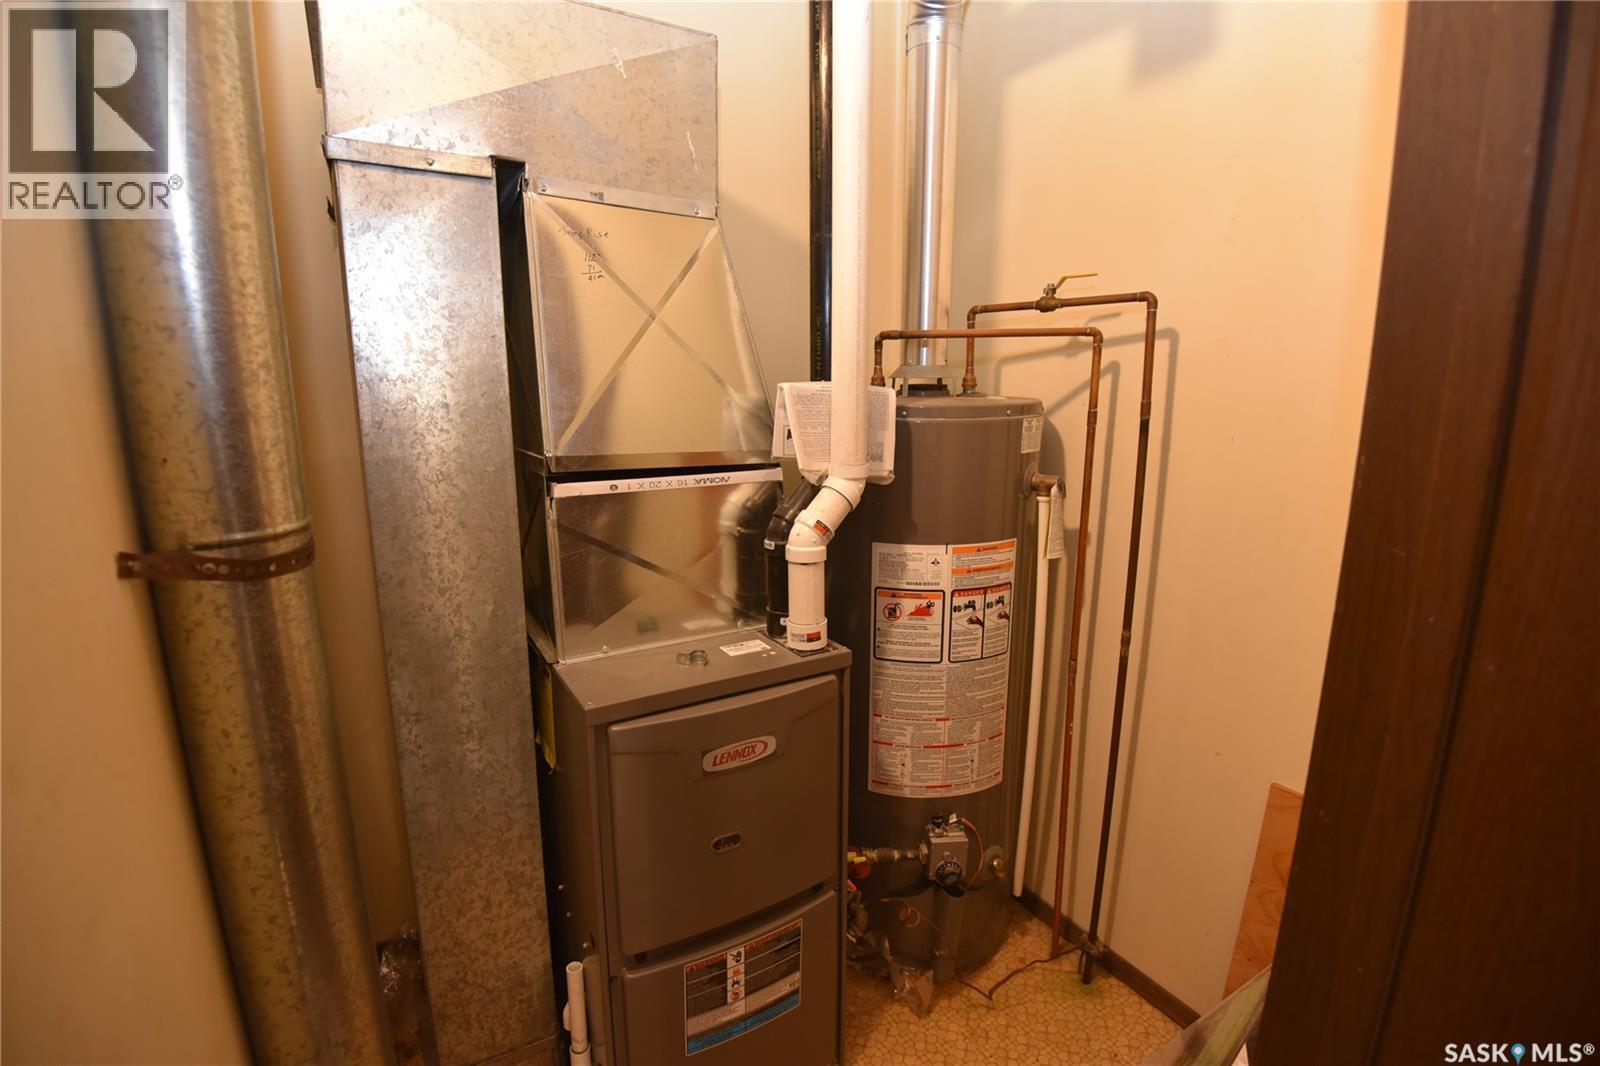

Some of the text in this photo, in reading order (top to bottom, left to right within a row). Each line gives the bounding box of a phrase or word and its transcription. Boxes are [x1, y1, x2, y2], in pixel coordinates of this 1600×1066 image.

[649, 480, 661, 489] 20
[677, 479, 688, 487] 16
[711, 743, 758, 768] LENNOX
